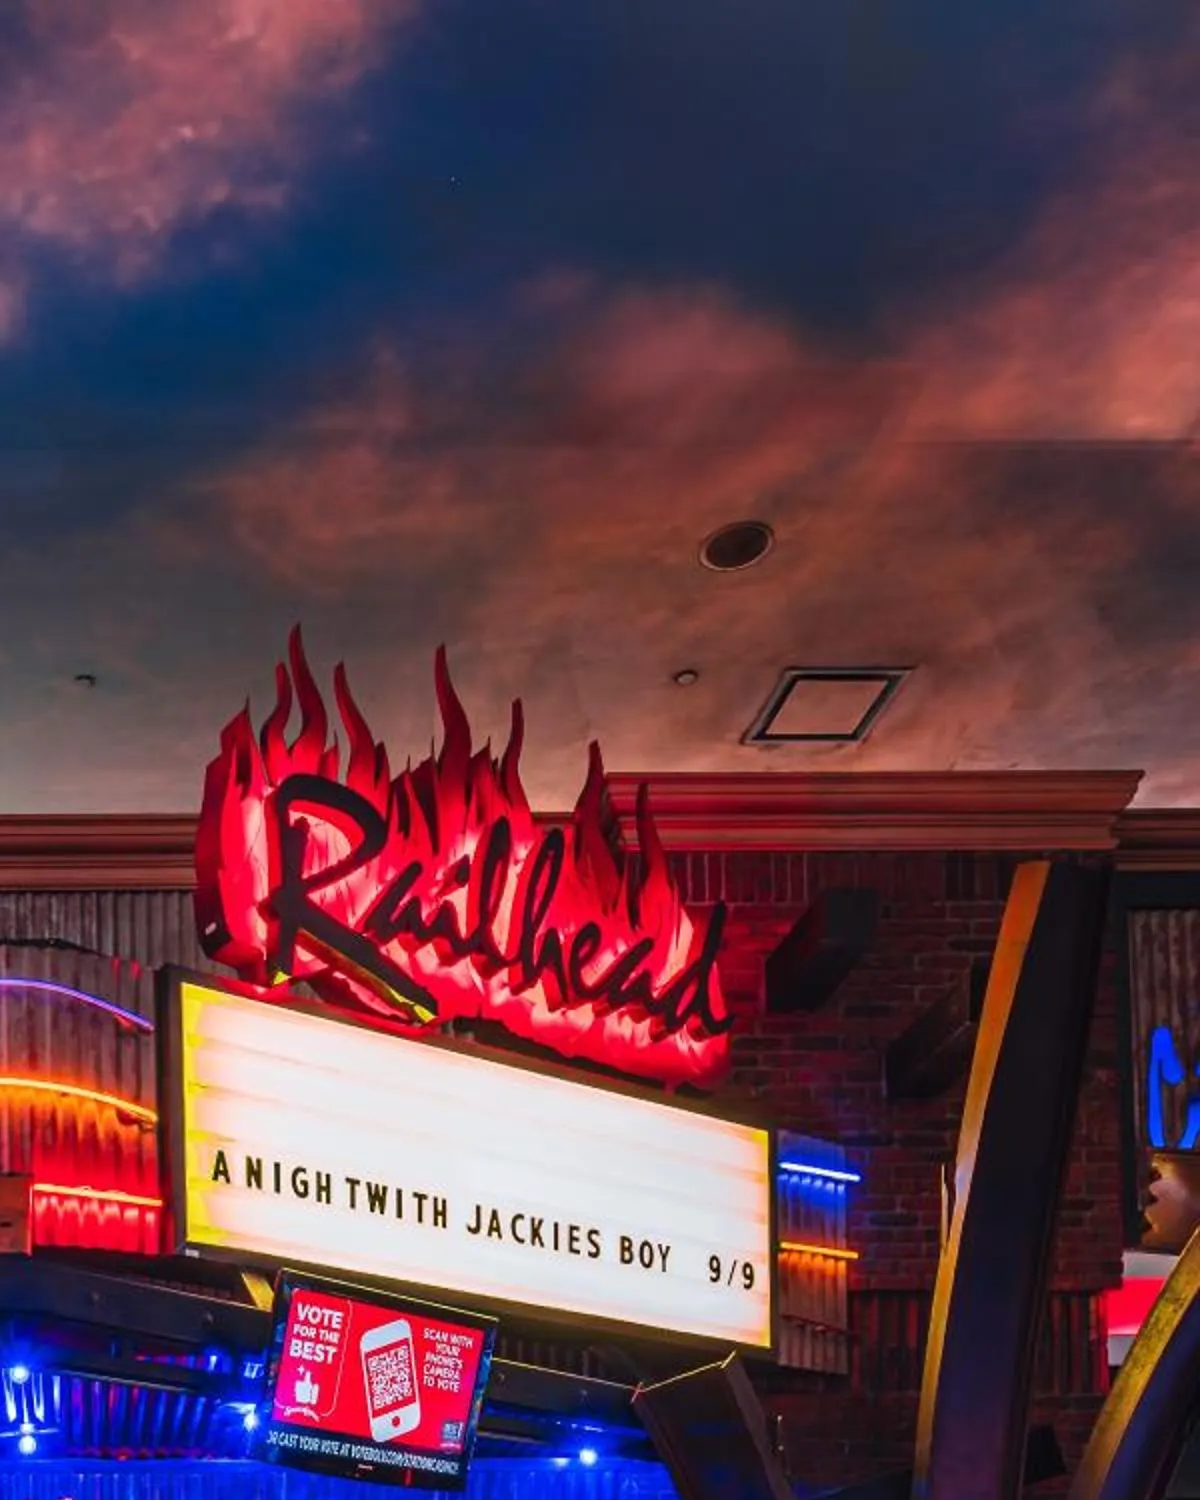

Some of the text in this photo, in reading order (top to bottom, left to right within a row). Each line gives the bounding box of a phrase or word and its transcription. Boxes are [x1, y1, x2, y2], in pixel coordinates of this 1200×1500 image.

[262, 774, 736, 1036] Railhead
[467, 1204, 600, 1259] JACKIES
[620, 1235, 671, 1274] BOY
[708, 1255, 756, 1292] 9/9
[297, 1303, 343, 1329] VOTE
[293, 1324, 340, 1344] FOR THE
[423, 1328, 473, 1348] SCAN WITH
[290, 1340, 337, 1365] BEST
[436, 1343, 461, 1357] YOUR
[423, 1365, 461, 1381] CAMERA
[437, 1379, 460, 1393] VOTE
